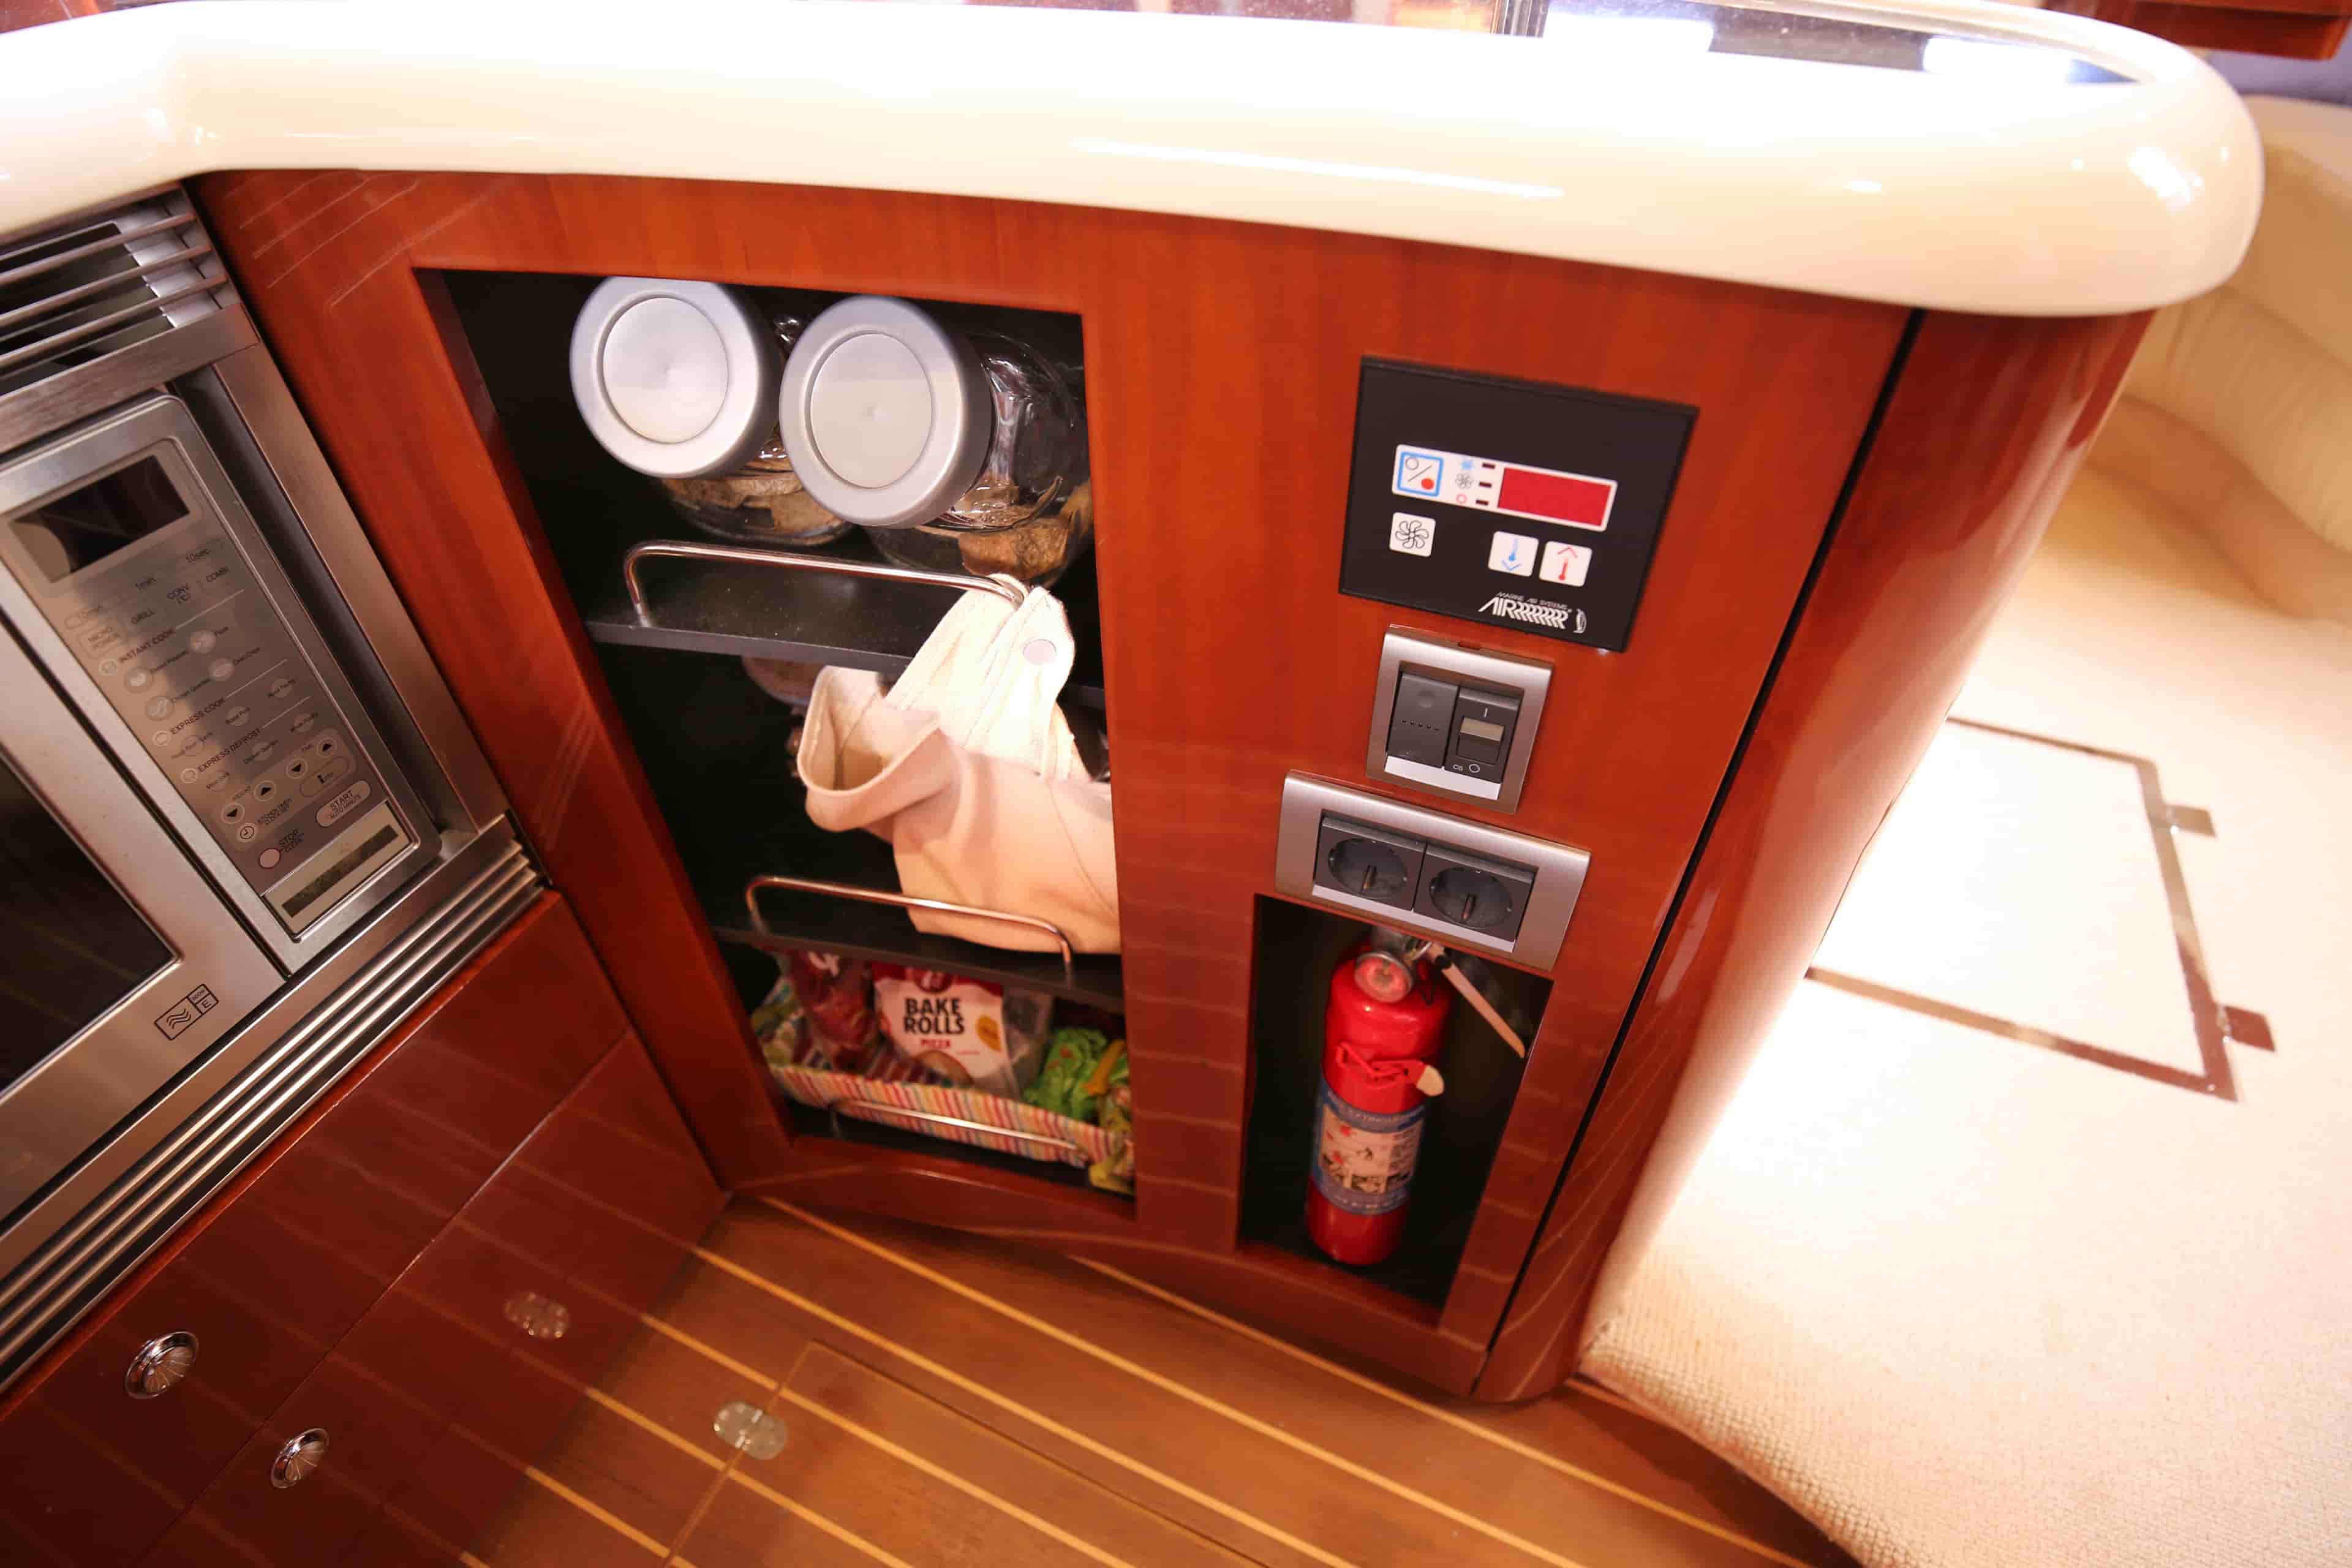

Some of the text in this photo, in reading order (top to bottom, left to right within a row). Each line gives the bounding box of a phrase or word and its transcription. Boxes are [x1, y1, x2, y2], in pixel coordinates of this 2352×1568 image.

[119, 641, 151, 664] INSTANT
[151, 628, 176, 644] COOK
[171, 696, 226, 736] EXPRESS COOK
[197, 748, 231, 773] EXPRESS
[230, 727, 260, 752] DEFROST
[330, 790, 353, 810] START
[279, 829, 300, 847] STOP
[904, 997, 961, 1016] BAKE
[903, 1015, 965, 1035] ROLLS
